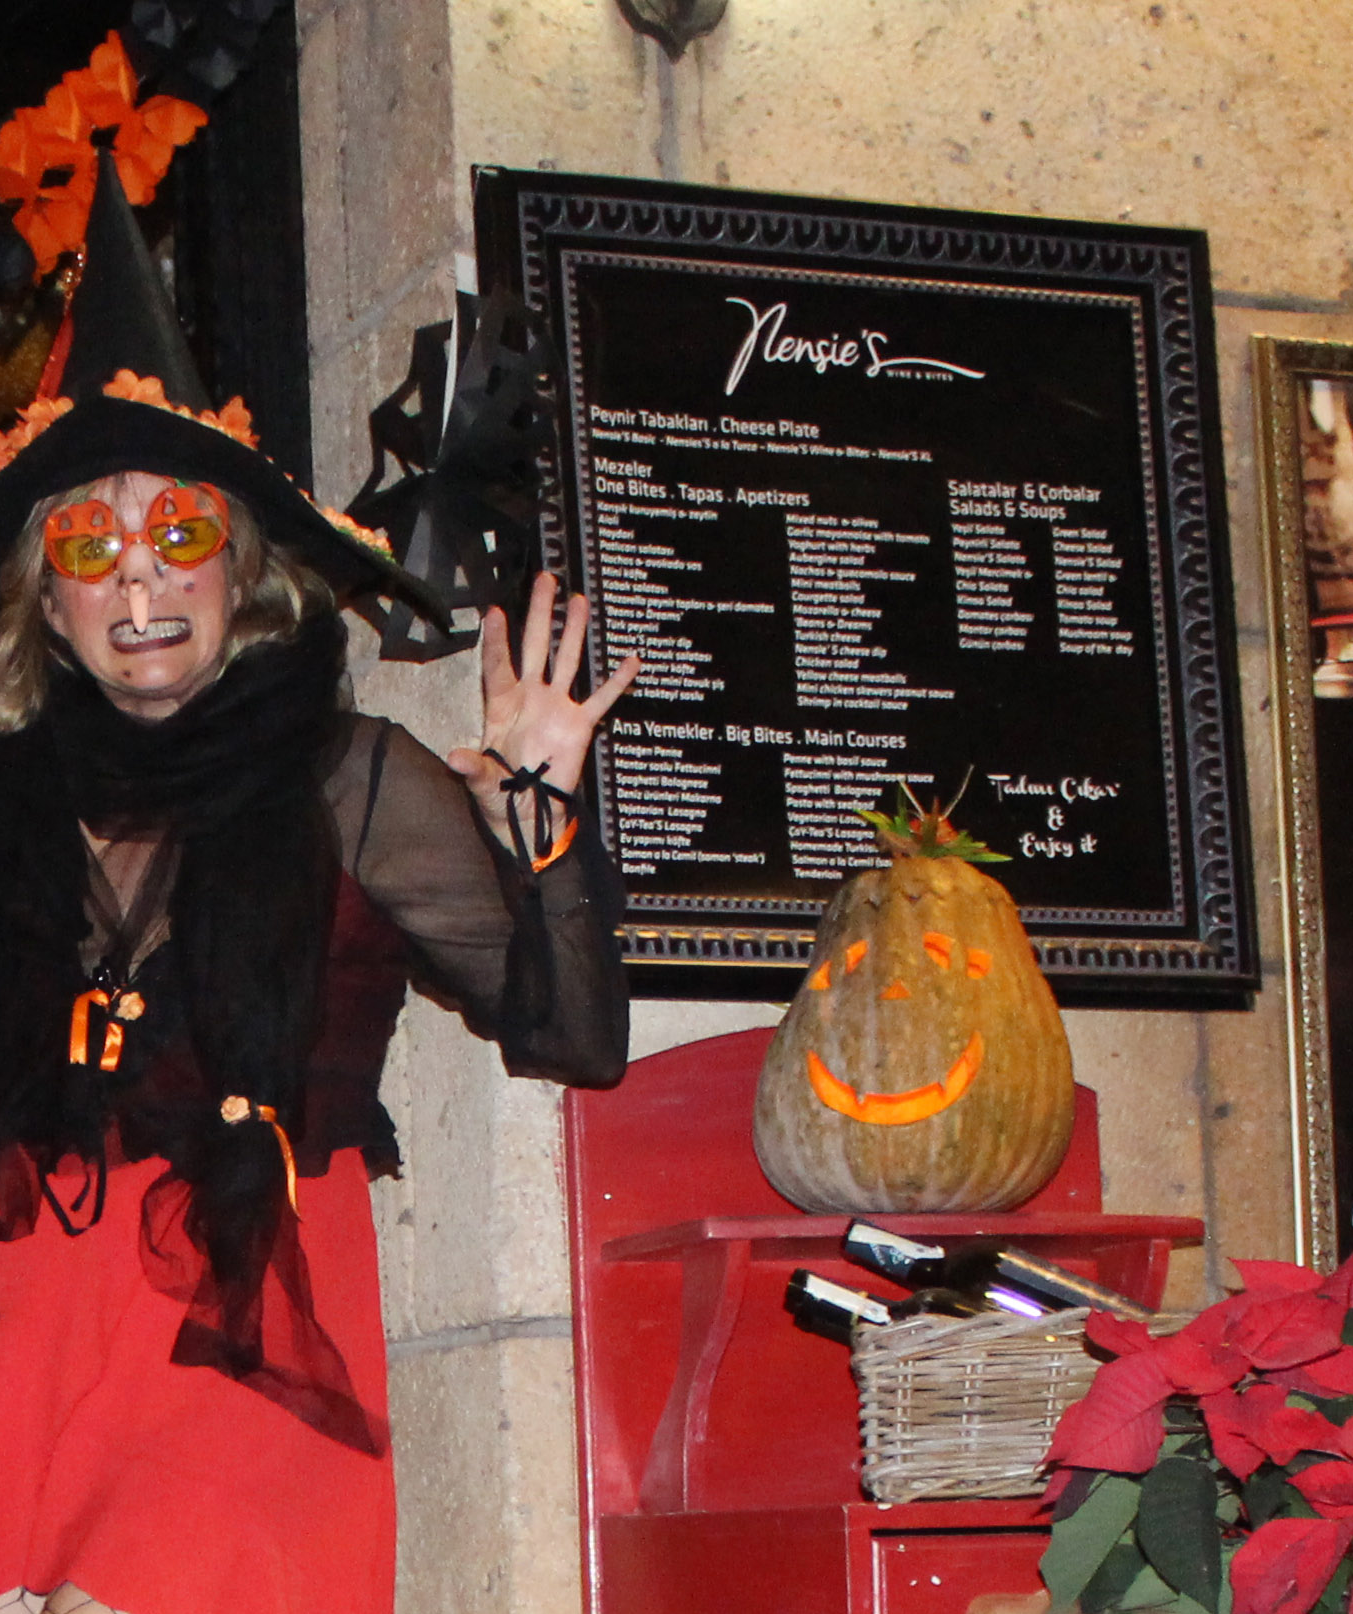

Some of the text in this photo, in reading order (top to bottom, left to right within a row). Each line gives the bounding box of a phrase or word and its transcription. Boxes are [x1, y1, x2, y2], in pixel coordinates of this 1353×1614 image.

[589, 405, 636, 426] Peynir
[719, 416, 775, 436] Cheese
[778, 419, 819, 438] Plate
[593, 456, 652, 477] Mezeler
[594, 475, 810, 510] One Bites Tapas Apetizers
[947, 479, 1016, 498] Salatalar
[1023, 482, 1035, 499] &
[949, 498, 1066, 521] Salads & Soups
[611, 720, 906, 748] Ana Yemekler Big Bites Main Courses
[1019, 833, 1098, 858] Enjoy it
